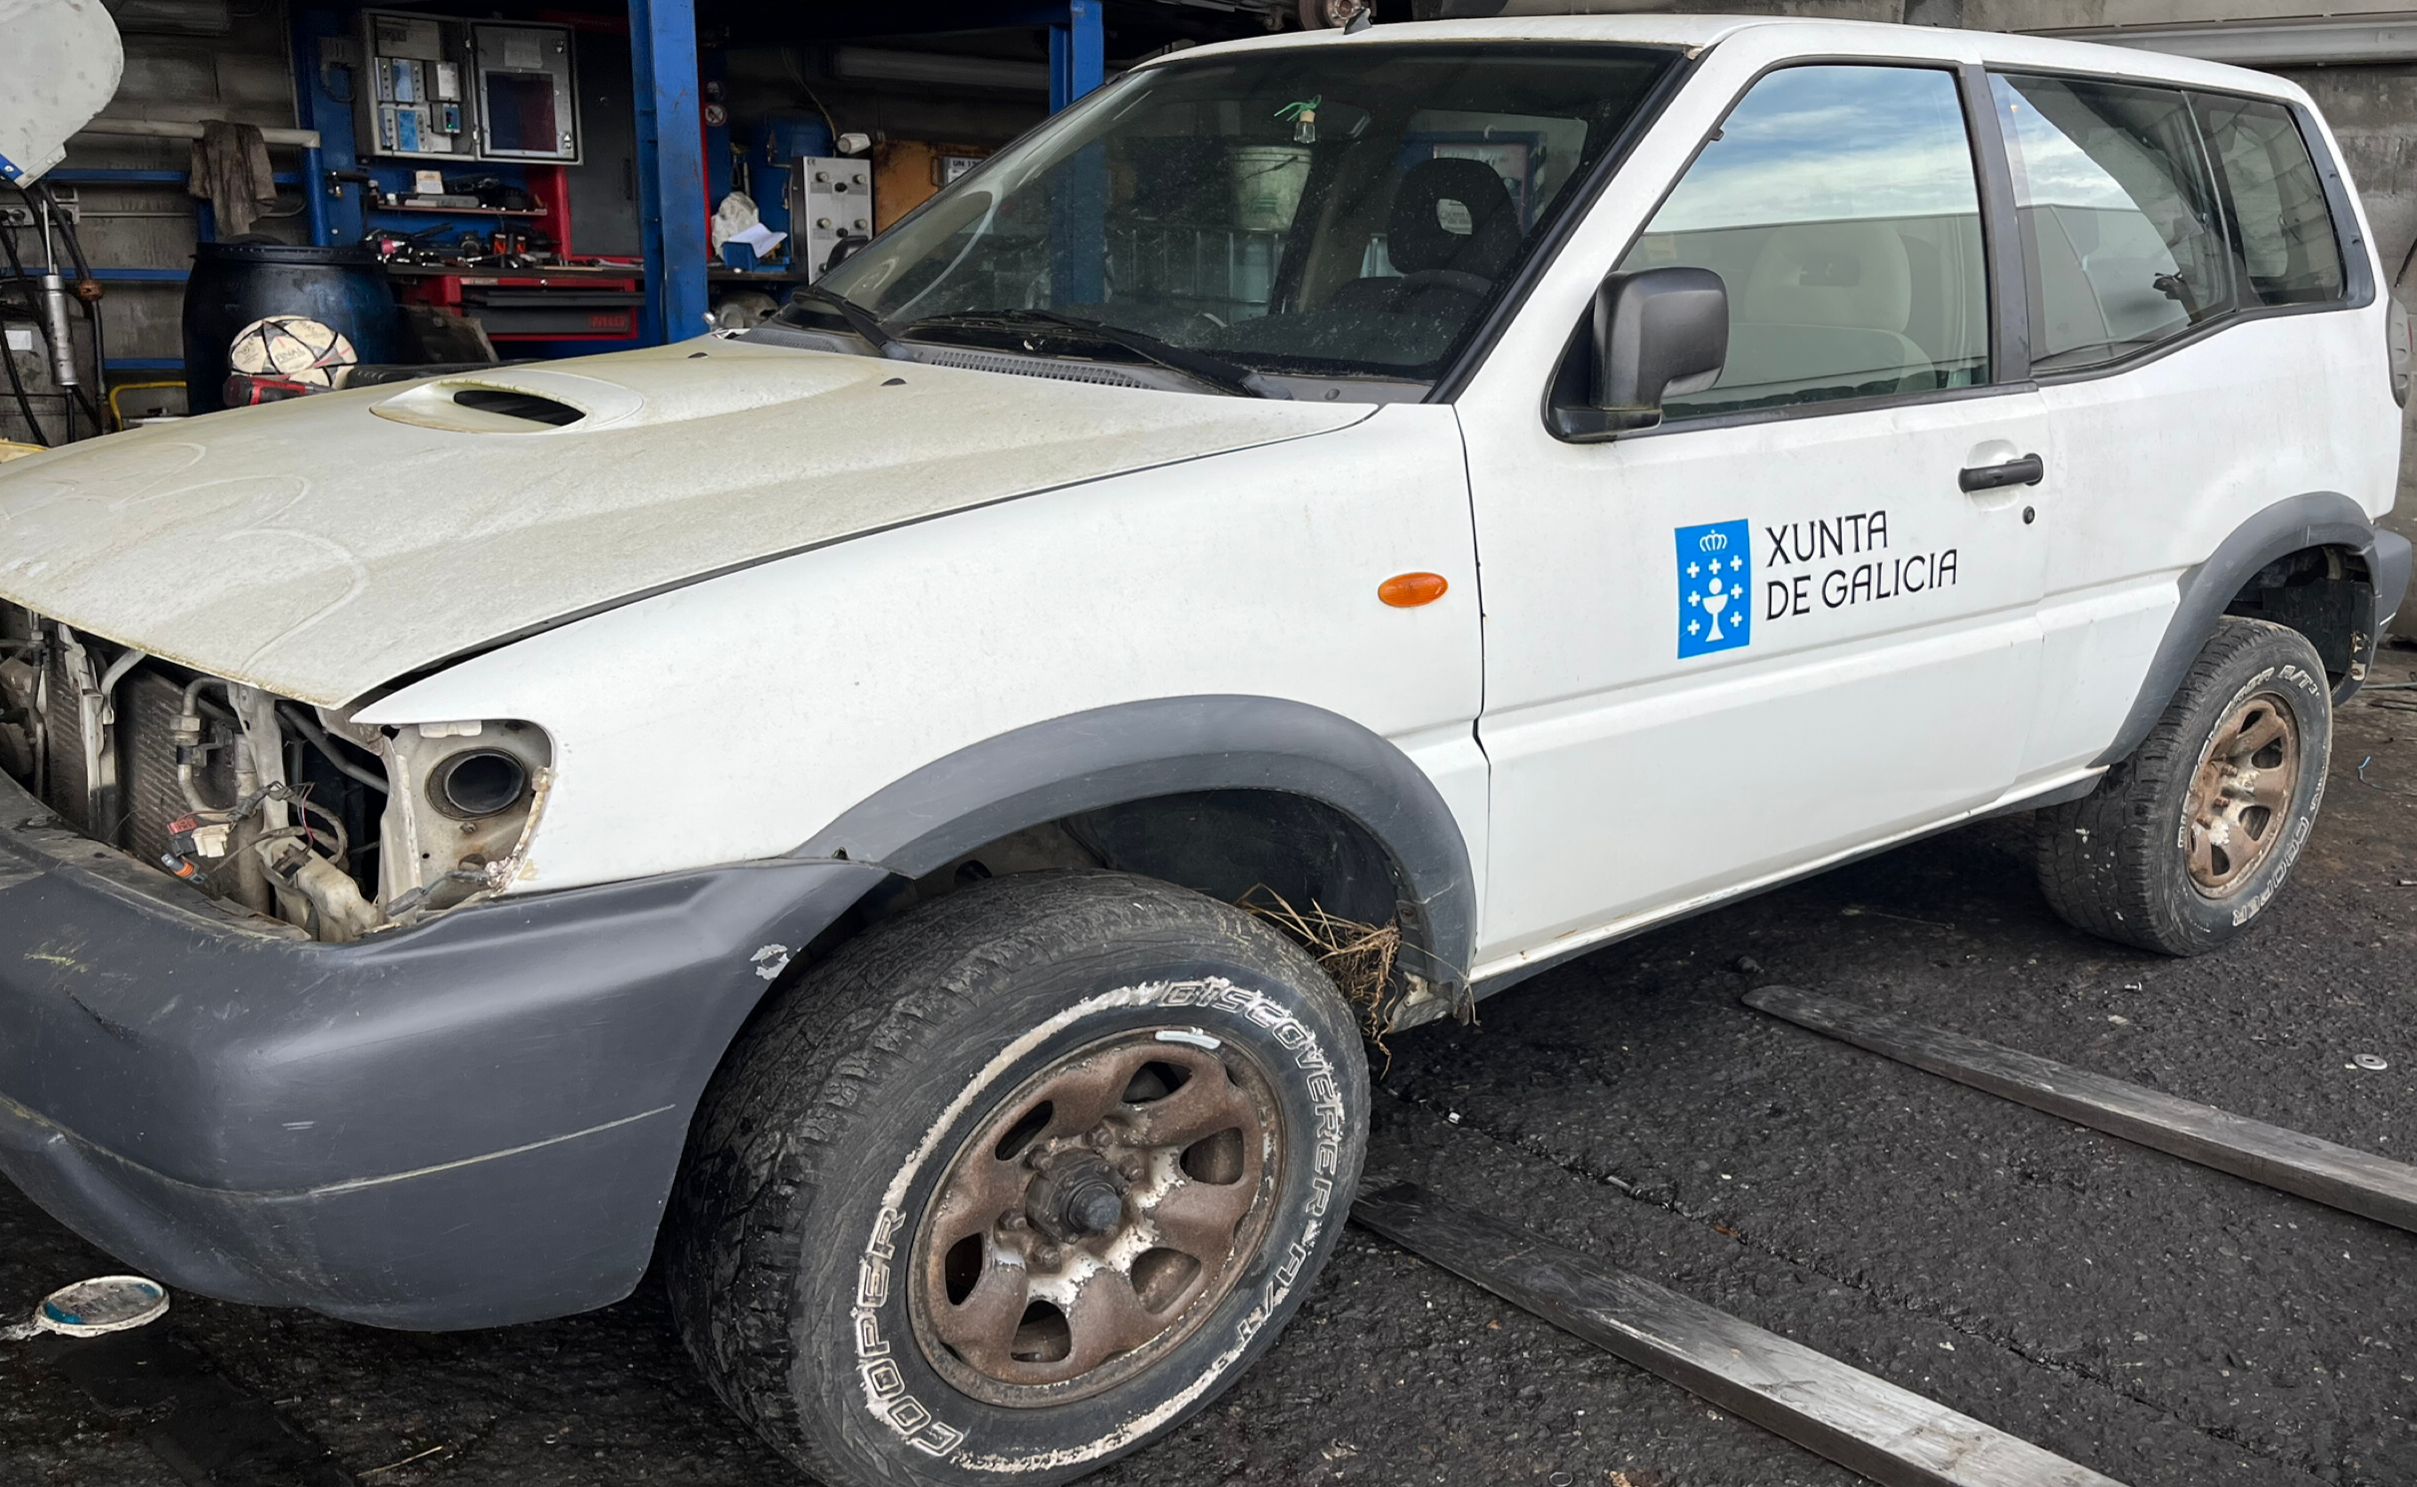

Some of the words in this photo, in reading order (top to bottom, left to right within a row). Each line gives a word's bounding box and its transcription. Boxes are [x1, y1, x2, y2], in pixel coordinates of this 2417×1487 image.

[1765, 510, 1888, 568] XUNTA
[1766, 575, 1811, 620] DE
[1821, 549, 1957, 609] GALICIA
[2232, 816, 2310, 926] COOPER
[1157, 979, 1341, 1217] DISCOVERER
[855, 1206, 964, 1457] COOPER
